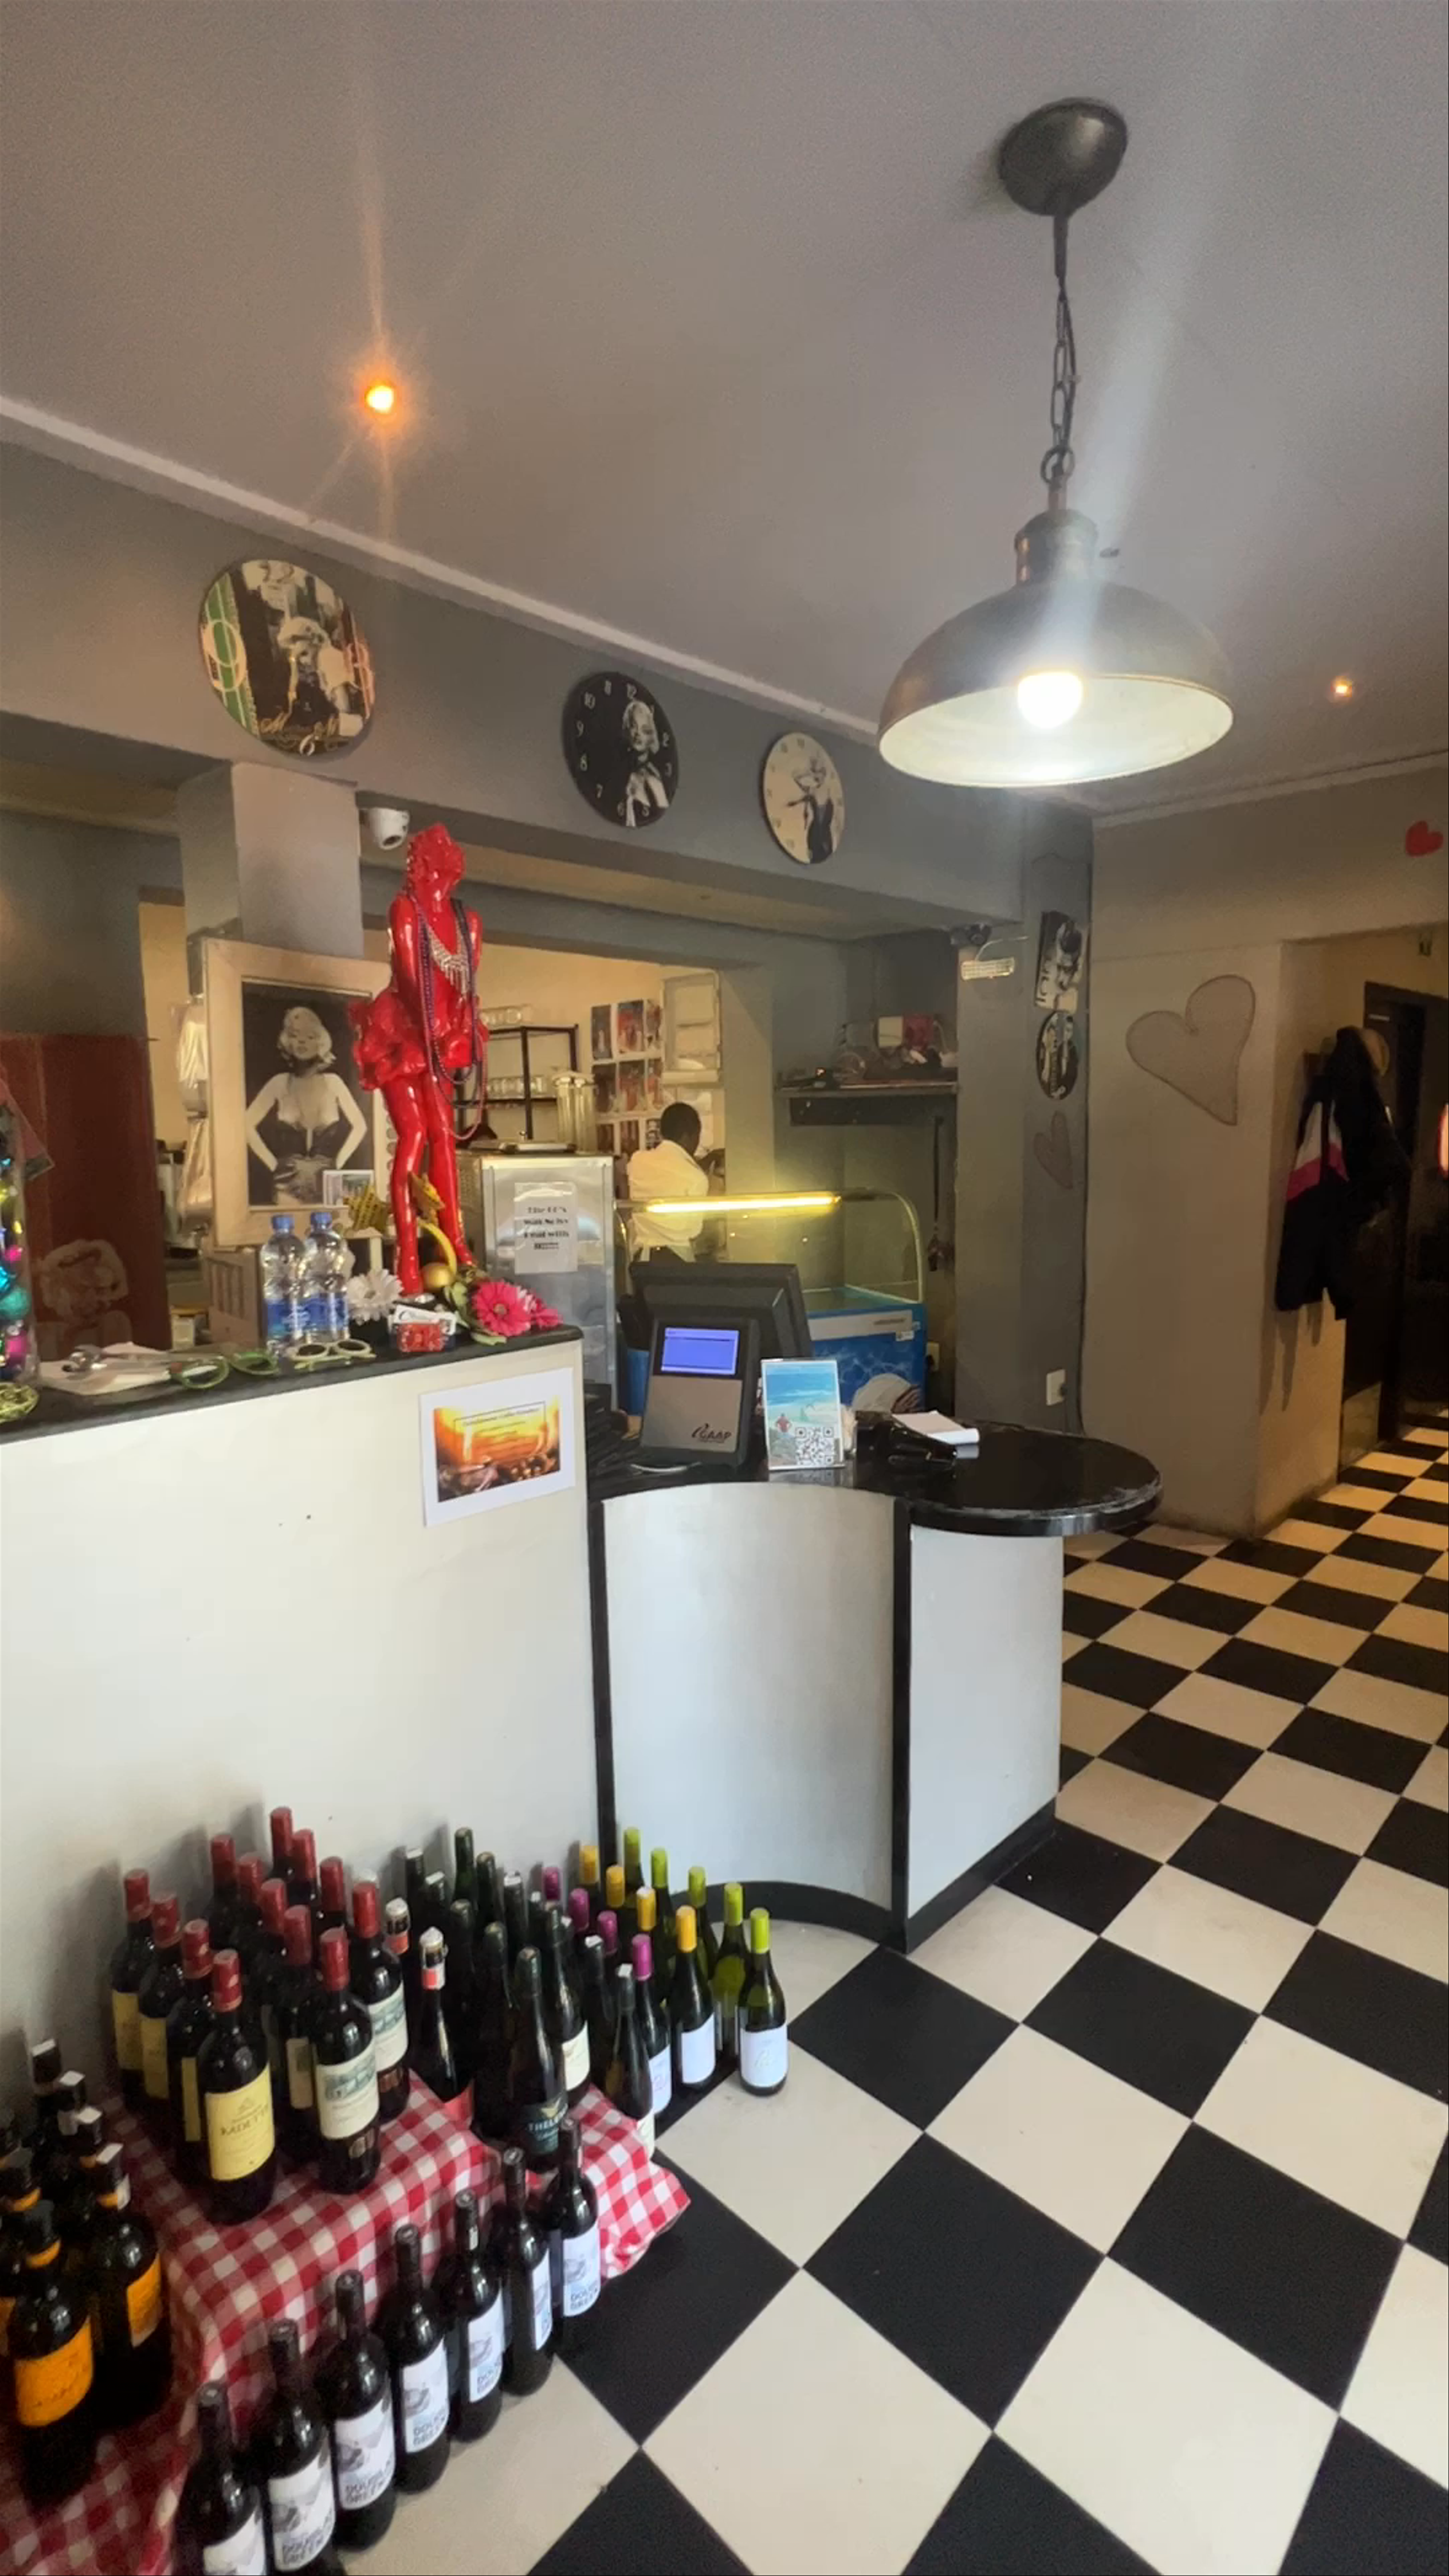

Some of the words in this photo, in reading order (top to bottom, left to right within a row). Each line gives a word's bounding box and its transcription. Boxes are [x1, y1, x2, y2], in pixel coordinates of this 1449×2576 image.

[585, 692, 595, 709] 10
[576, 720, 584, 737] 9
[663, 732, 669, 747] 2
[580, 753, 588, 772] 8
[665, 762, 672, 777] 3
[596, 783, 603, 798] 7
[617, 800, 624, 817] 6
